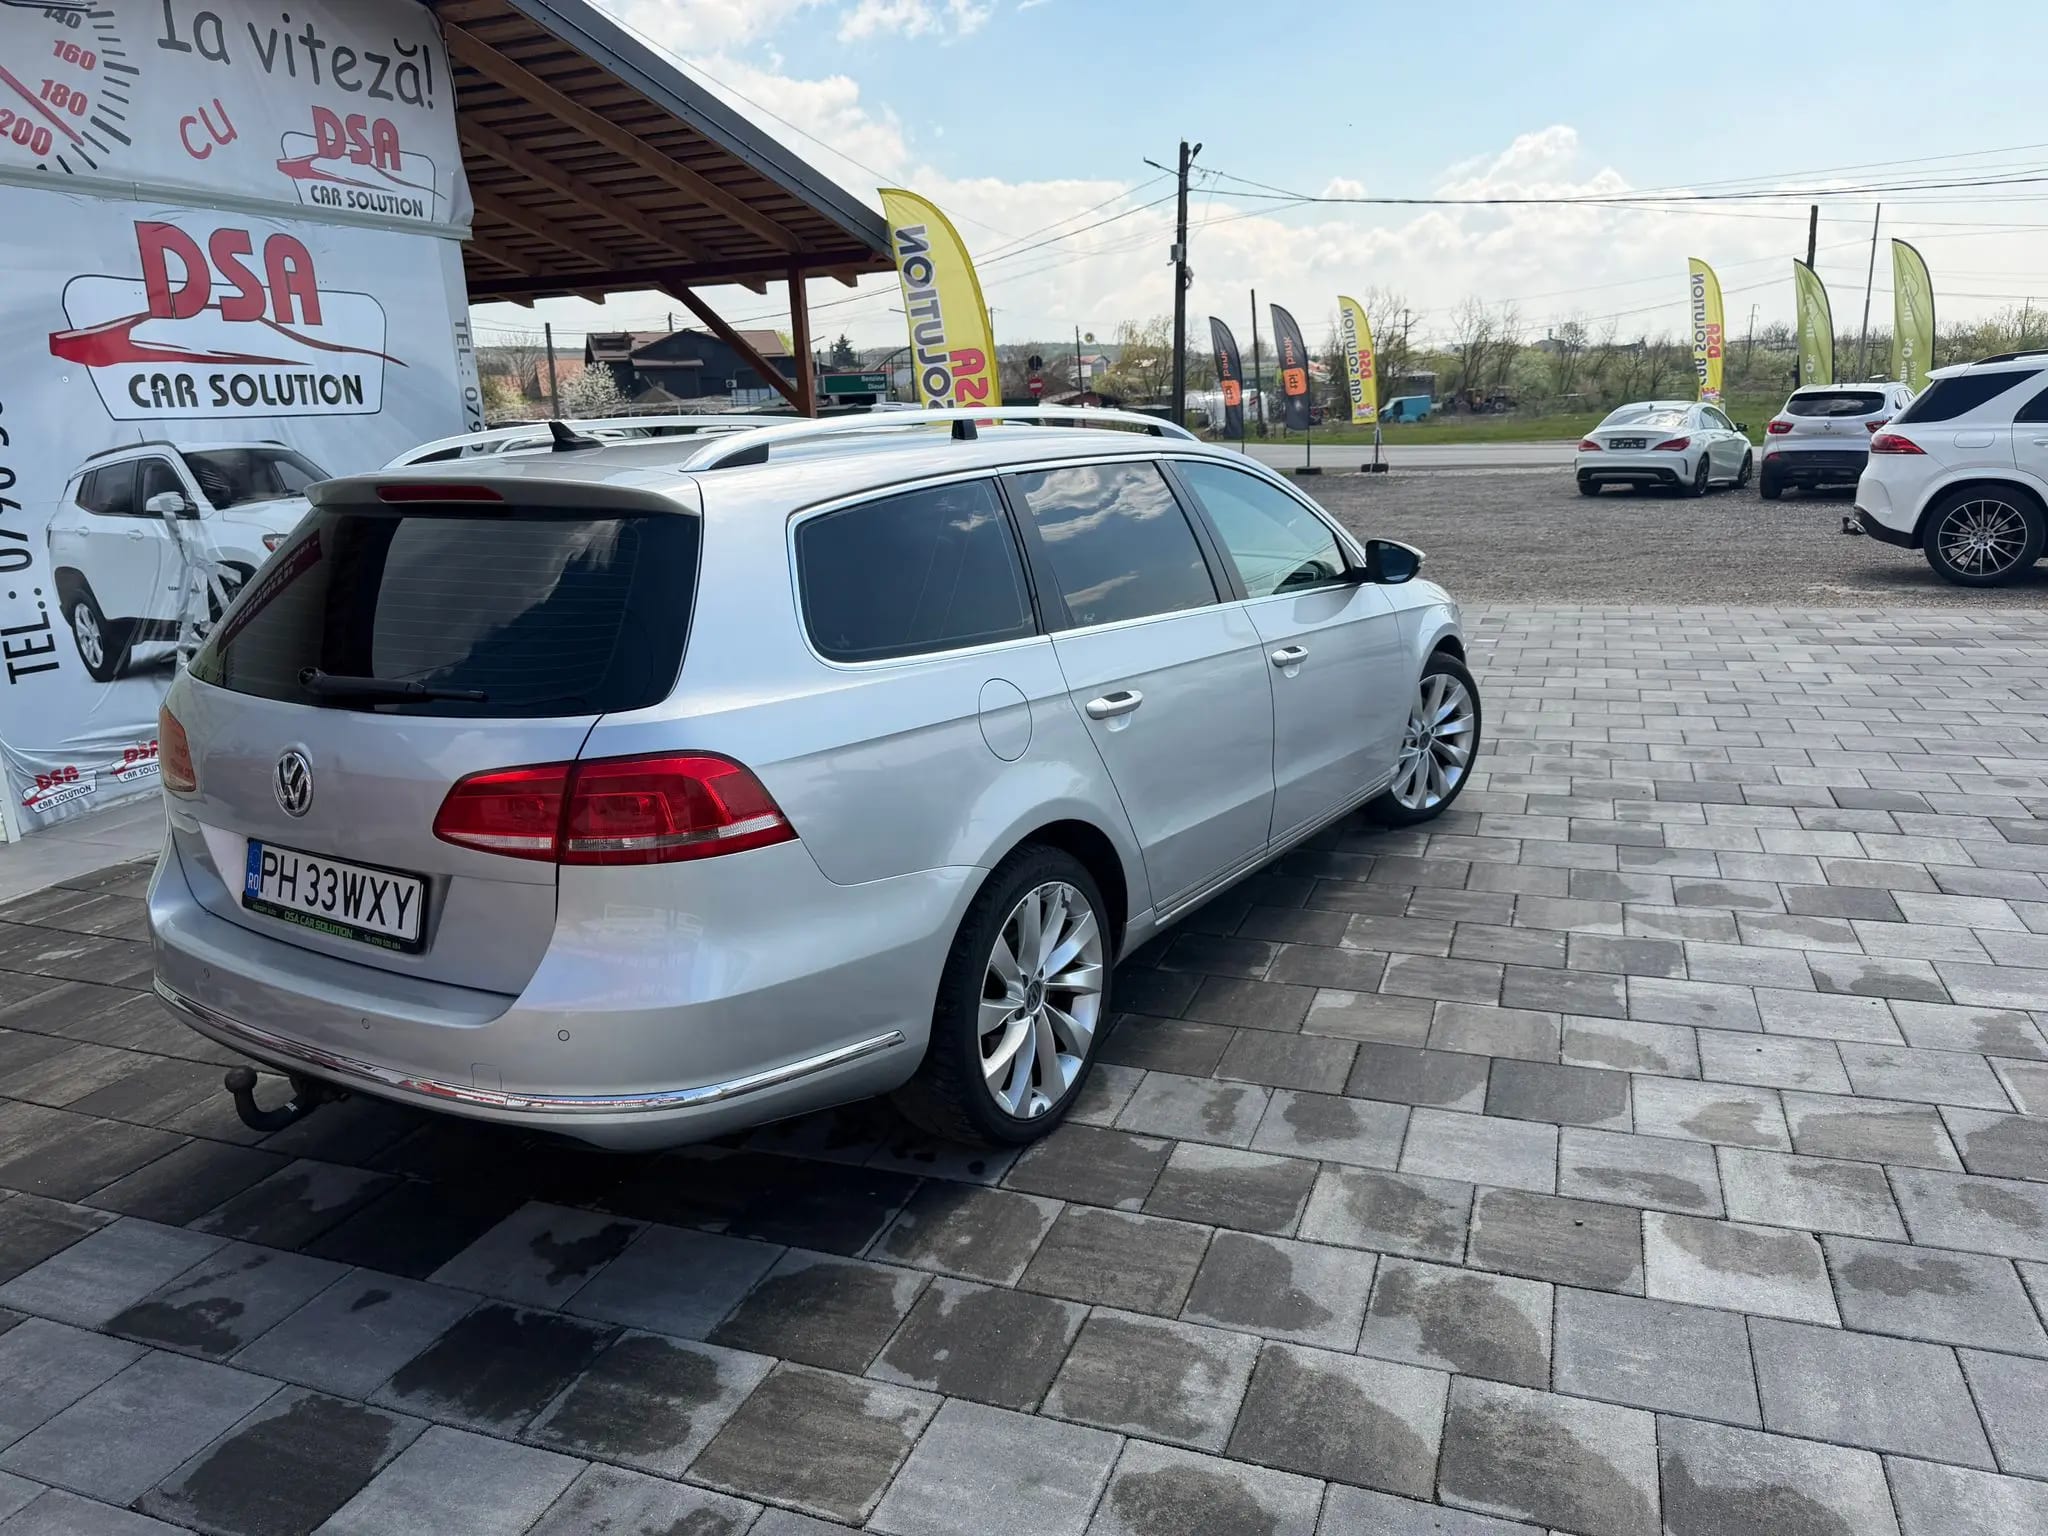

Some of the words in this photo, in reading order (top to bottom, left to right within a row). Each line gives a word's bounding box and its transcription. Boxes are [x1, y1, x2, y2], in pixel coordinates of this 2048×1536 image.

[43, 8, 82, 29] 140
[53, 40, 97, 71] 160
[247, 13, 434, 110] viteză!
[40, 79, 88, 117] 180
[0, 108, 53, 156] 200
[179, 98, 237, 160] cu
[312, 105, 402, 172] DSA
[310, 185, 342, 207] CAR
[347, 191, 424, 217] SOLUTION
[134, 220, 323, 326] DSA
[128, 373, 197, 407] CAR
[207, 373, 364, 406] SOLUTION
[35, 765, 80, 791] DSA
[123, 771, 138, 780] CAR
[38, 799, 53, 810] CAR
[55, 785, 92, 804] SOLUTION
[247, 872, 259, 890] RO
[260, 850, 299, 902] PH
[300, 914, 315, 928] CAR
[315, 919, 353, 939] SOLUTION
